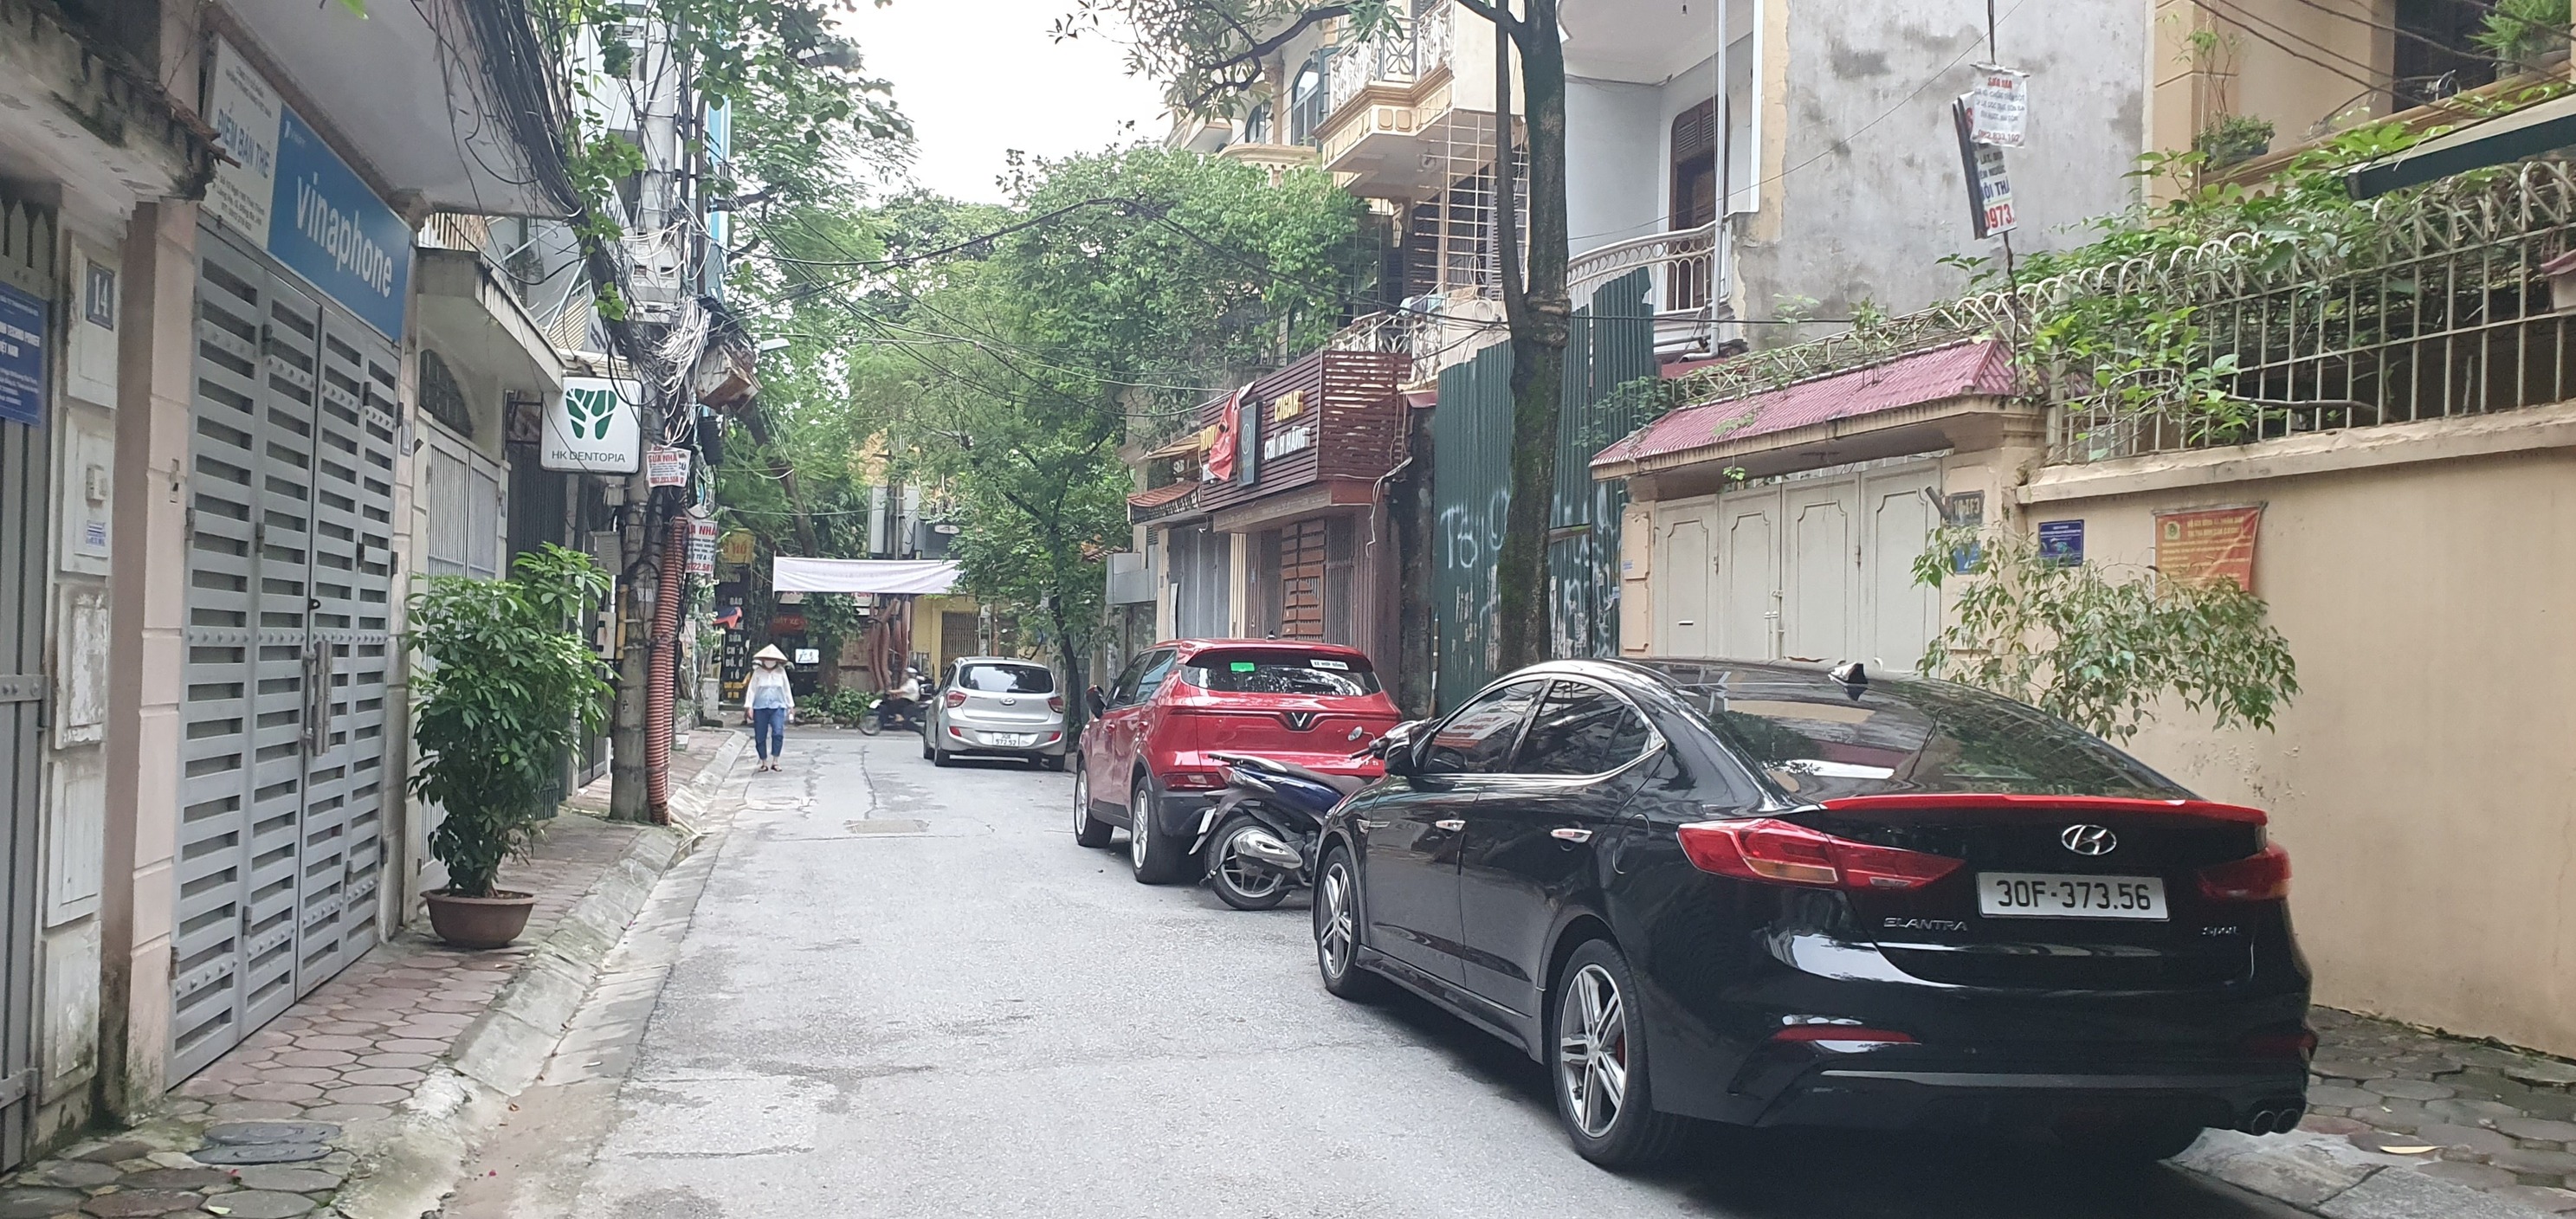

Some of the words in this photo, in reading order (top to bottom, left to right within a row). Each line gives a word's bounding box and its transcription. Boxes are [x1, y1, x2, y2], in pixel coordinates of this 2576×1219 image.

[297, 171, 393, 299] vinaphone
[94, 273, 109, 319] 14
[1274, 390, 1303, 423] CIGAR
[552, 450, 567, 460] HK
[569, 451, 626, 463] DENTOPIA
[1996, 880, 2152, 911] 30F-373.56
[1883, 917, 1968, 932] ELANTRA
